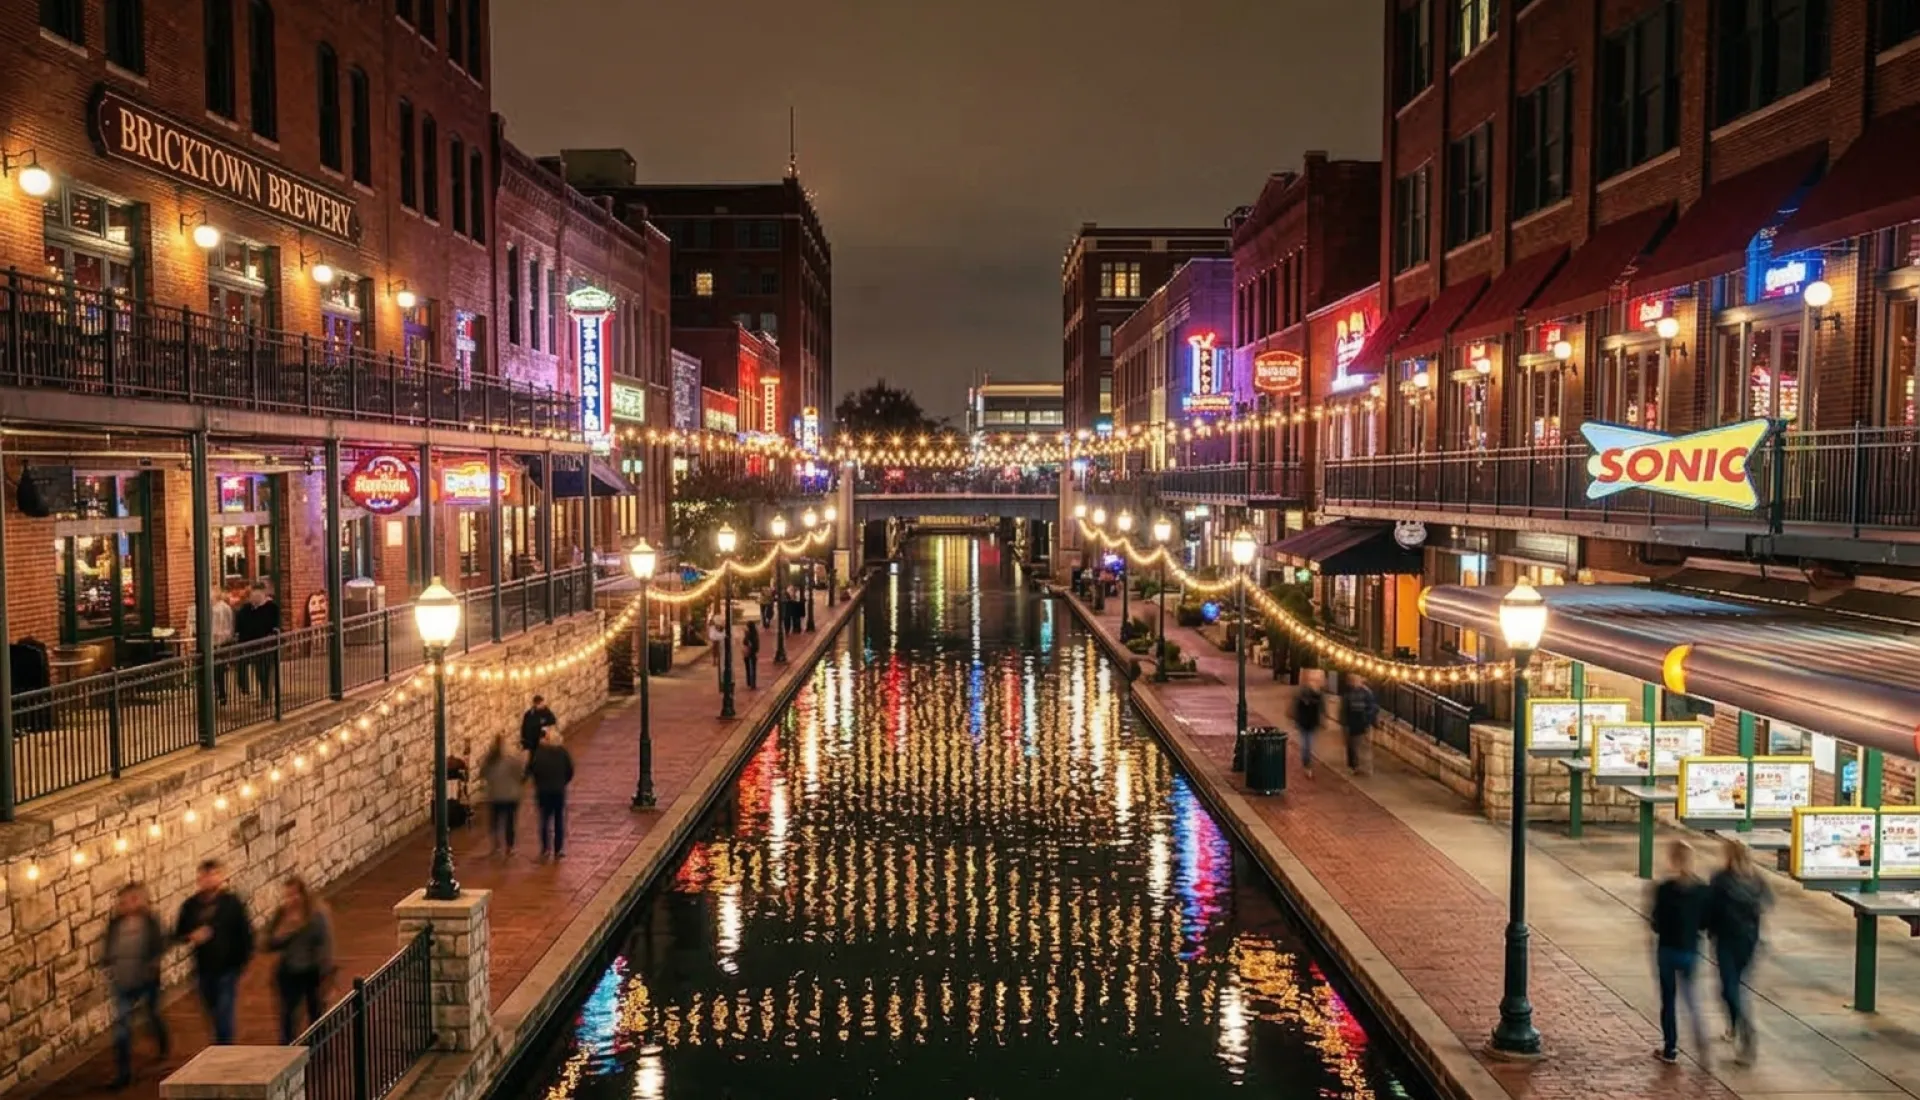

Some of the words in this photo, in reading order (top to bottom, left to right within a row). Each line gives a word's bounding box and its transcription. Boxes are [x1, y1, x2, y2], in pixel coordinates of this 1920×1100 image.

[119, 107, 261, 202] BRICKTOWN
[267, 172, 352, 238] BREWERY
[1596, 446, 1750, 483] SONIC
